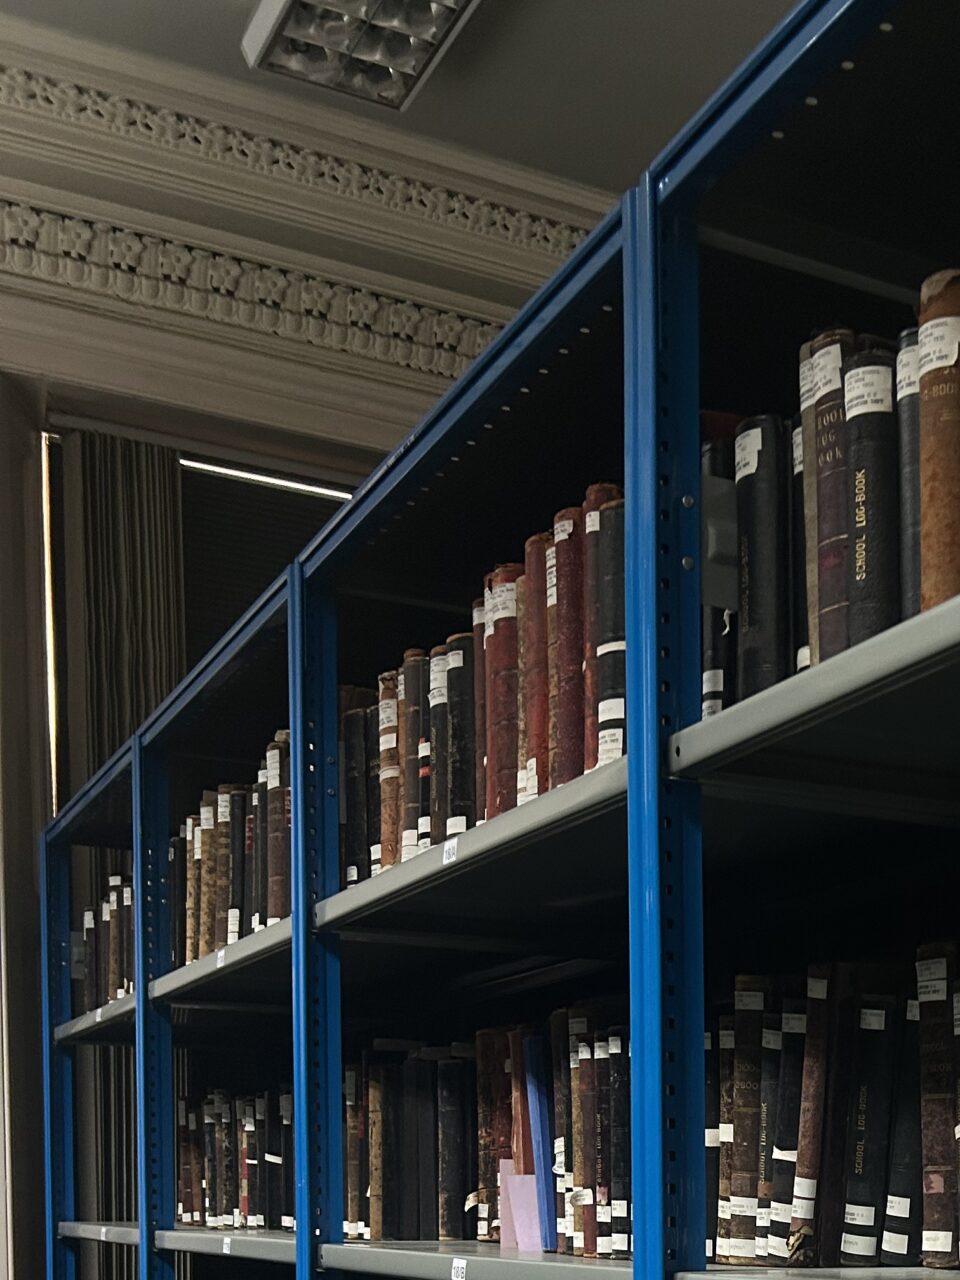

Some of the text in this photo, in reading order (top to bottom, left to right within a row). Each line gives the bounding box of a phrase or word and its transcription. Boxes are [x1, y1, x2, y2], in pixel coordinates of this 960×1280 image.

[855, 468, 866, 581] SCHOOL LOG-BOOK
[855, 1139, 865, 1175] SCHOOL
